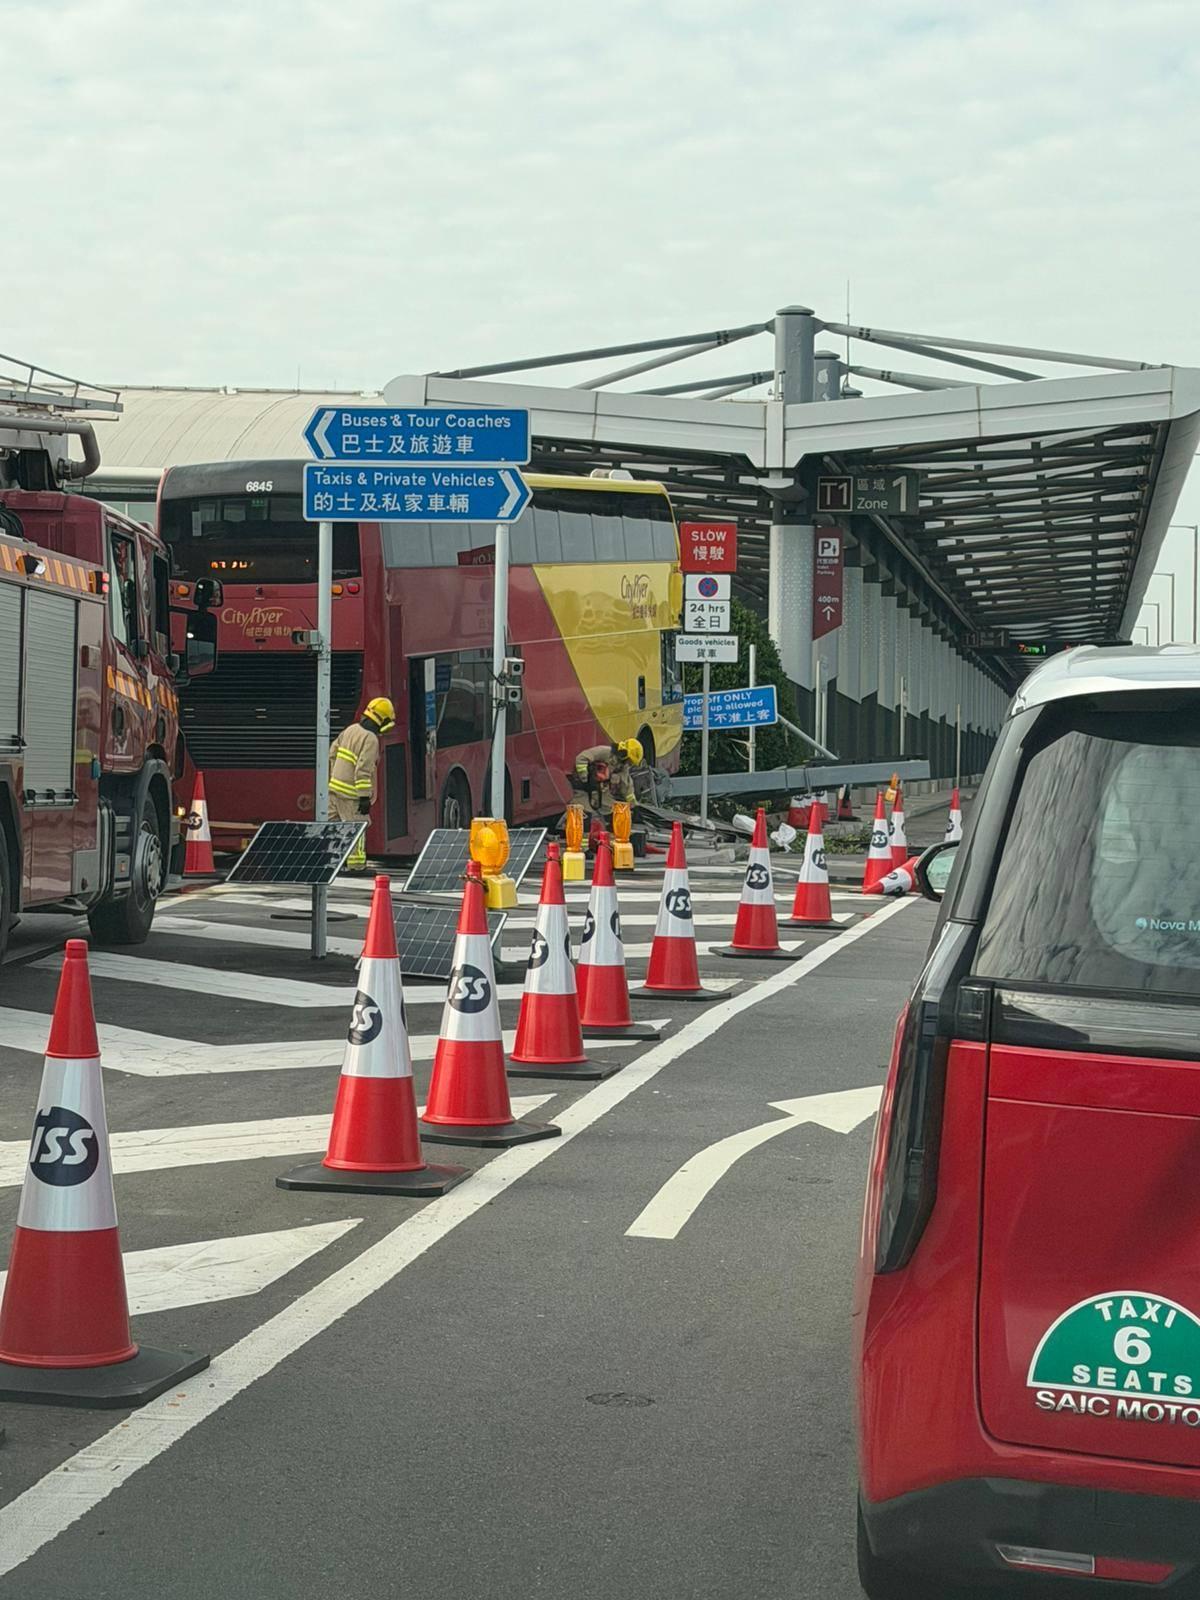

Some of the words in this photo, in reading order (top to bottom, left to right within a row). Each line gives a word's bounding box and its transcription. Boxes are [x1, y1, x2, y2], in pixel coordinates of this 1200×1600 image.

[341, 413, 387, 427] Buses
[392, 414, 402, 427] &
[407, 413, 440, 427] Tour
[445, 414, 511, 428] Coaches
[341, 434, 475, 455] 巴士及旅遊車
[314, 471, 352, 485] Taxis
[357, 473, 367, 485] &
[373, 472, 426, 486] Private
[432, 472, 495, 487] Vehicles
[857, 478, 886, 491] 區域
[245, 481, 273, 492] 6845
[820, 482, 848, 505] T1
[892, 475, 907, 512] 1
[313, 492, 469, 513] 的士及私家車輛
[857, 498, 888, 509] Zone
[691, 531, 727, 541] SLOW
[693, 546, 725, 560] 慢駛
[690, 604, 705, 612] 24
[708, 604, 725, 612] hrs
[693, 616, 721, 629] 全日
[704, 638, 736, 646] vehicles
[696, 648, 717, 658] 貨車
[723, 691, 753, 702] ONLY
[725, 699, 764, 711] allowed
[746, 870, 768, 883] ISS
[1150, 919, 1183, 930] Nova
[448, 976, 488, 1000] ISS
[349, 1004, 379, 1032] SS
[29, 1126, 94, 1165] ISS
[1095, 1299, 1177, 1328] TAXI
[1114, 1326, 1152, 1365] 6
[1072, 1364, 1193, 1395] SEATS
[1035, 1390, 1110, 1416] SAIC
